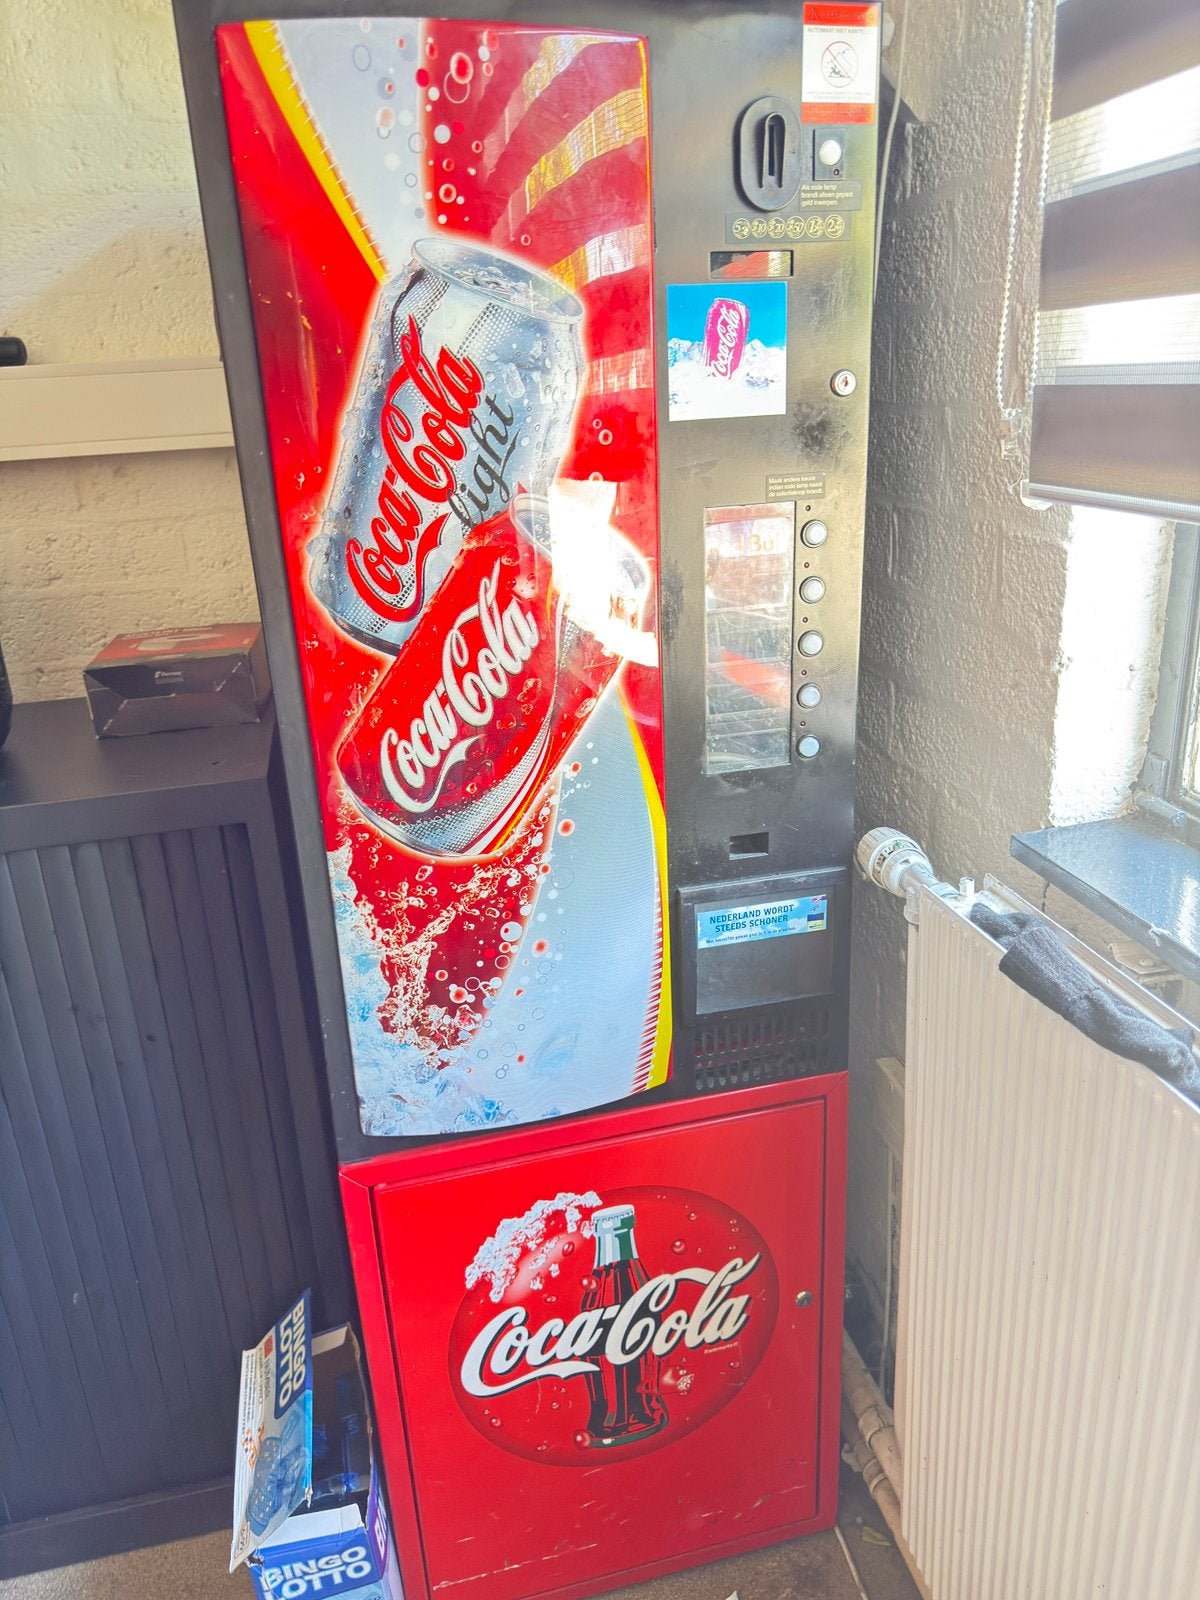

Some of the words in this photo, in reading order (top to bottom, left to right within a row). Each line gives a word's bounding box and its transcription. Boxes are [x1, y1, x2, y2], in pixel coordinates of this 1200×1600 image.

[346, 313, 486, 623] Coca-Cola
[446, 392, 520, 535] light
[380, 558, 540, 814] Coca-Cola
[709, 908, 761, 924] NEDERLAND
[763, 904, 795, 916] WORDT
[715, 922, 747, 933] STEEDS
[749, 914, 788, 928] SCHONER
[279, 1312, 293, 1408] LOTTO
[293, 1298, 306, 1391] BINGO
[460, 1252, 760, 1397] Coca-Cola
[261, 1546, 367, 1590] BINGO
[264, 1560, 371, 1600] LOTTO
